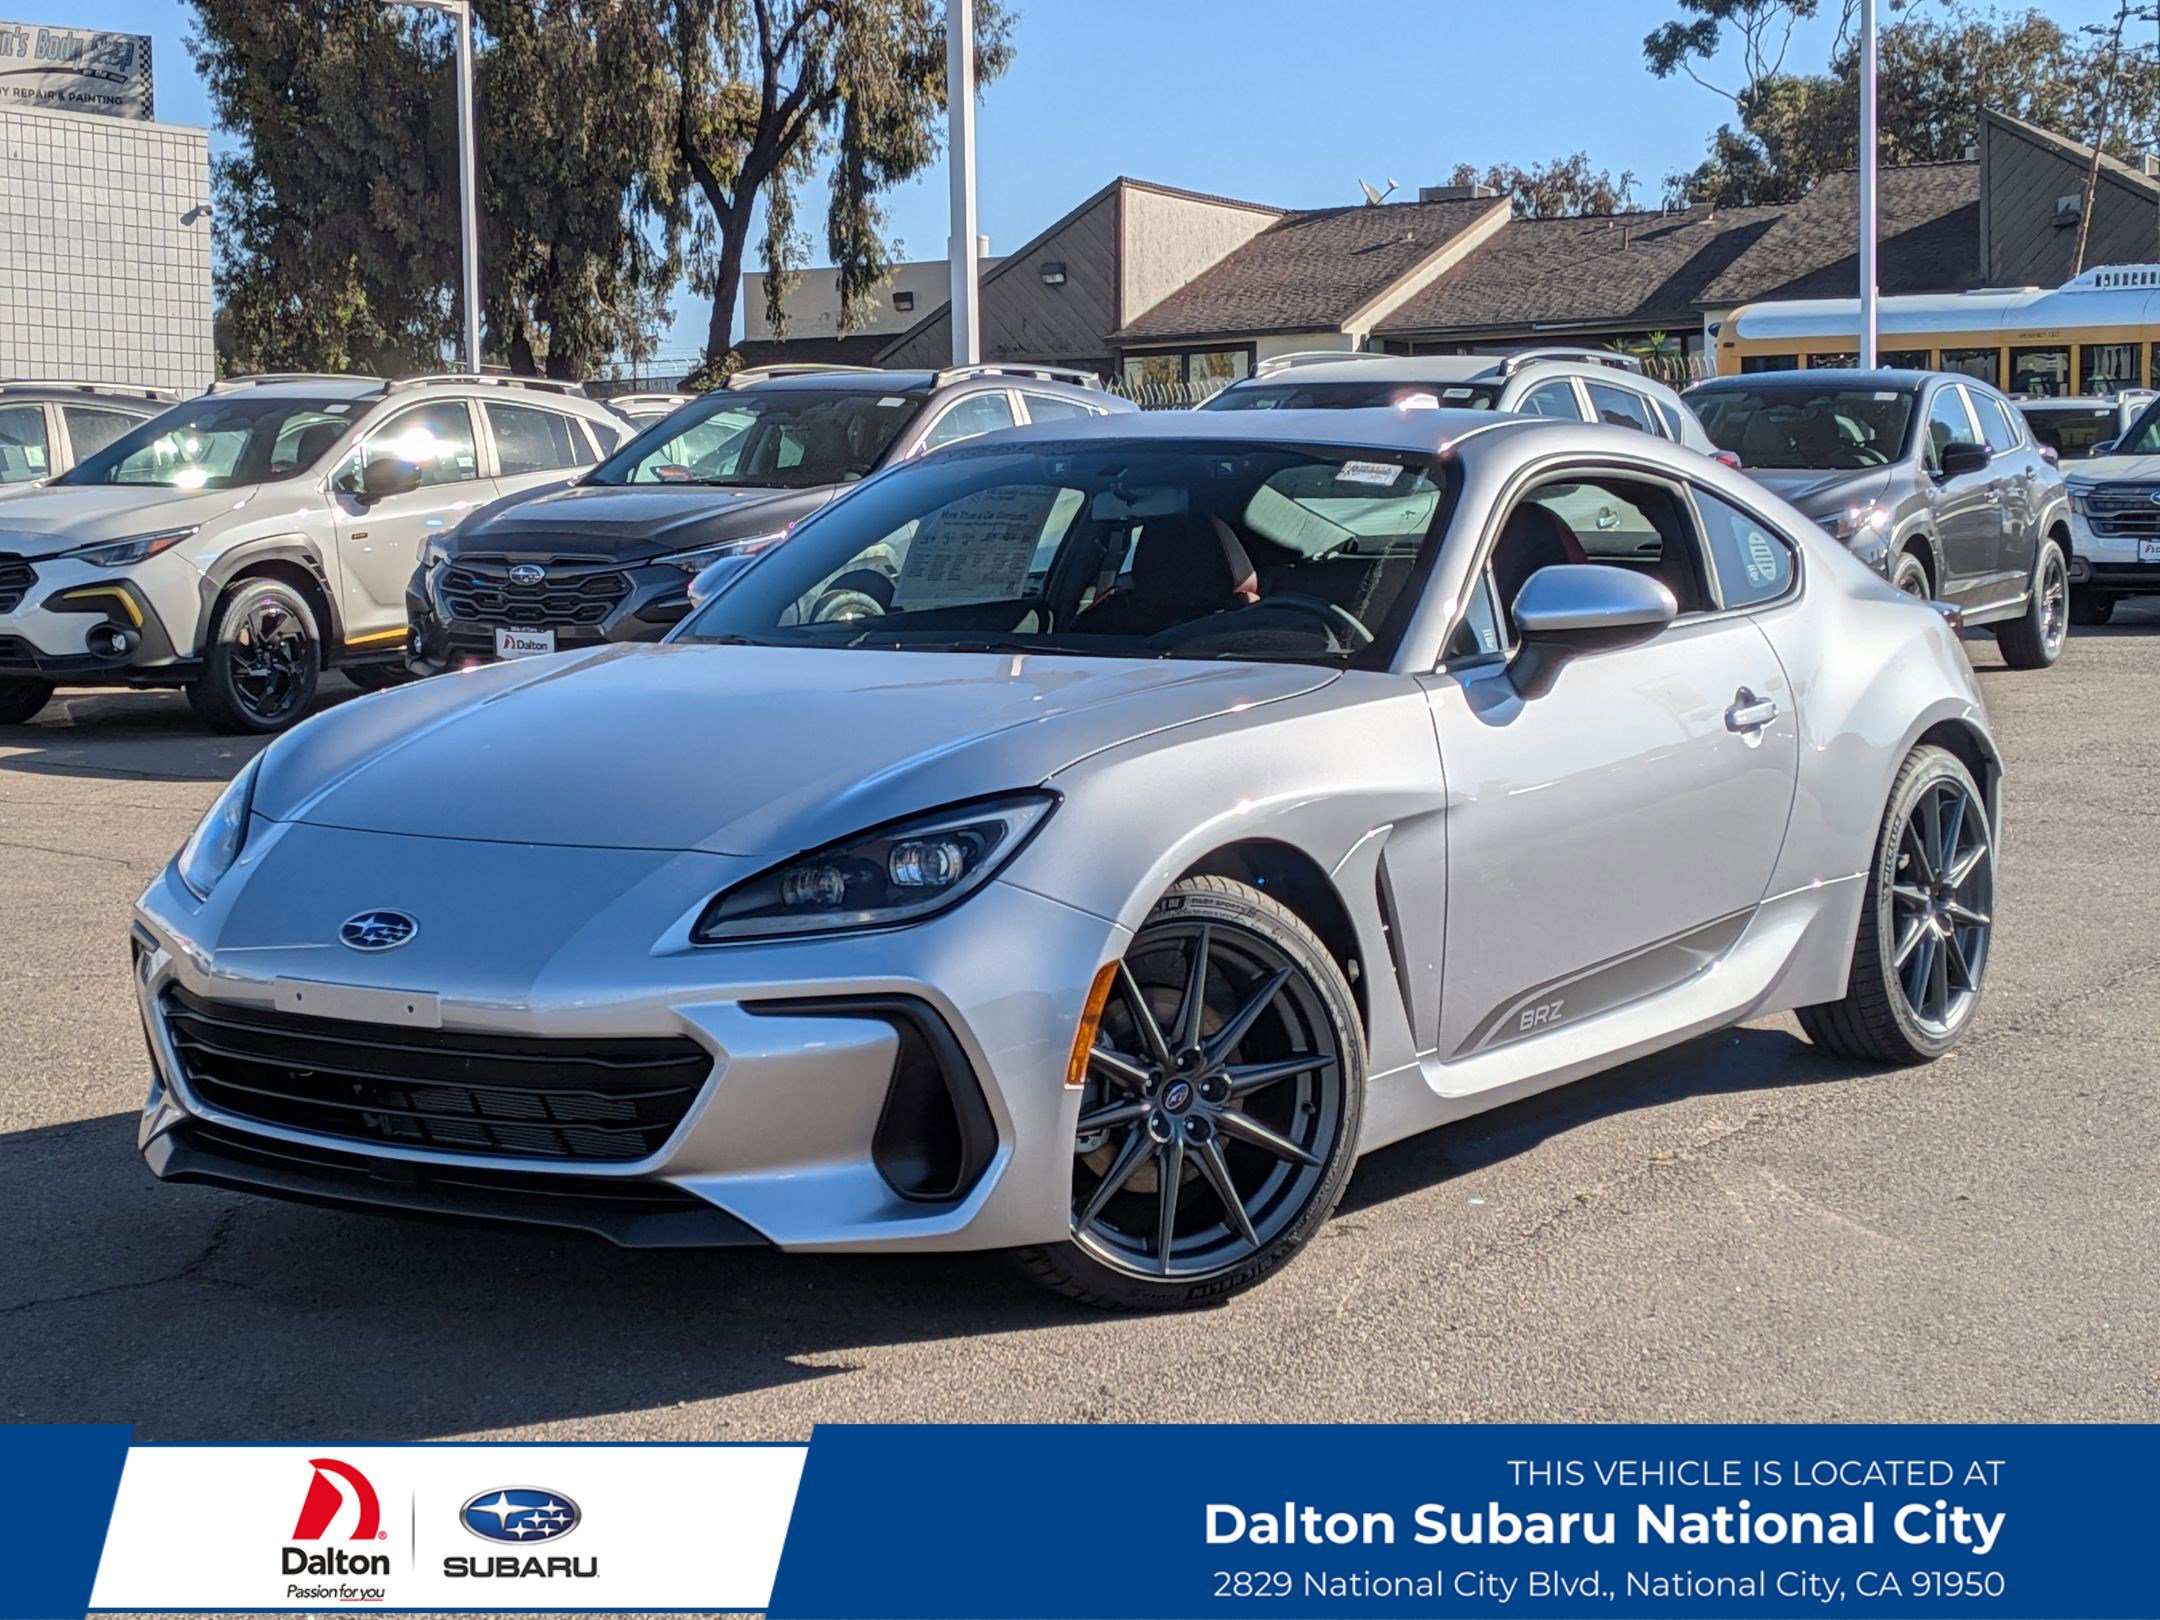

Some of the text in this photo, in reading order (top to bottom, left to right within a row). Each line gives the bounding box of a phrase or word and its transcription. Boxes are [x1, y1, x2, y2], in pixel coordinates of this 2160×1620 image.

[34, 29, 83, 70] Body
[13, 87, 55, 100] REPAIR
[69, 92, 123, 105] PAINTING
[516, 639, 548, 651] Dalton
[1519, 999, 1565, 1031] BRZ
